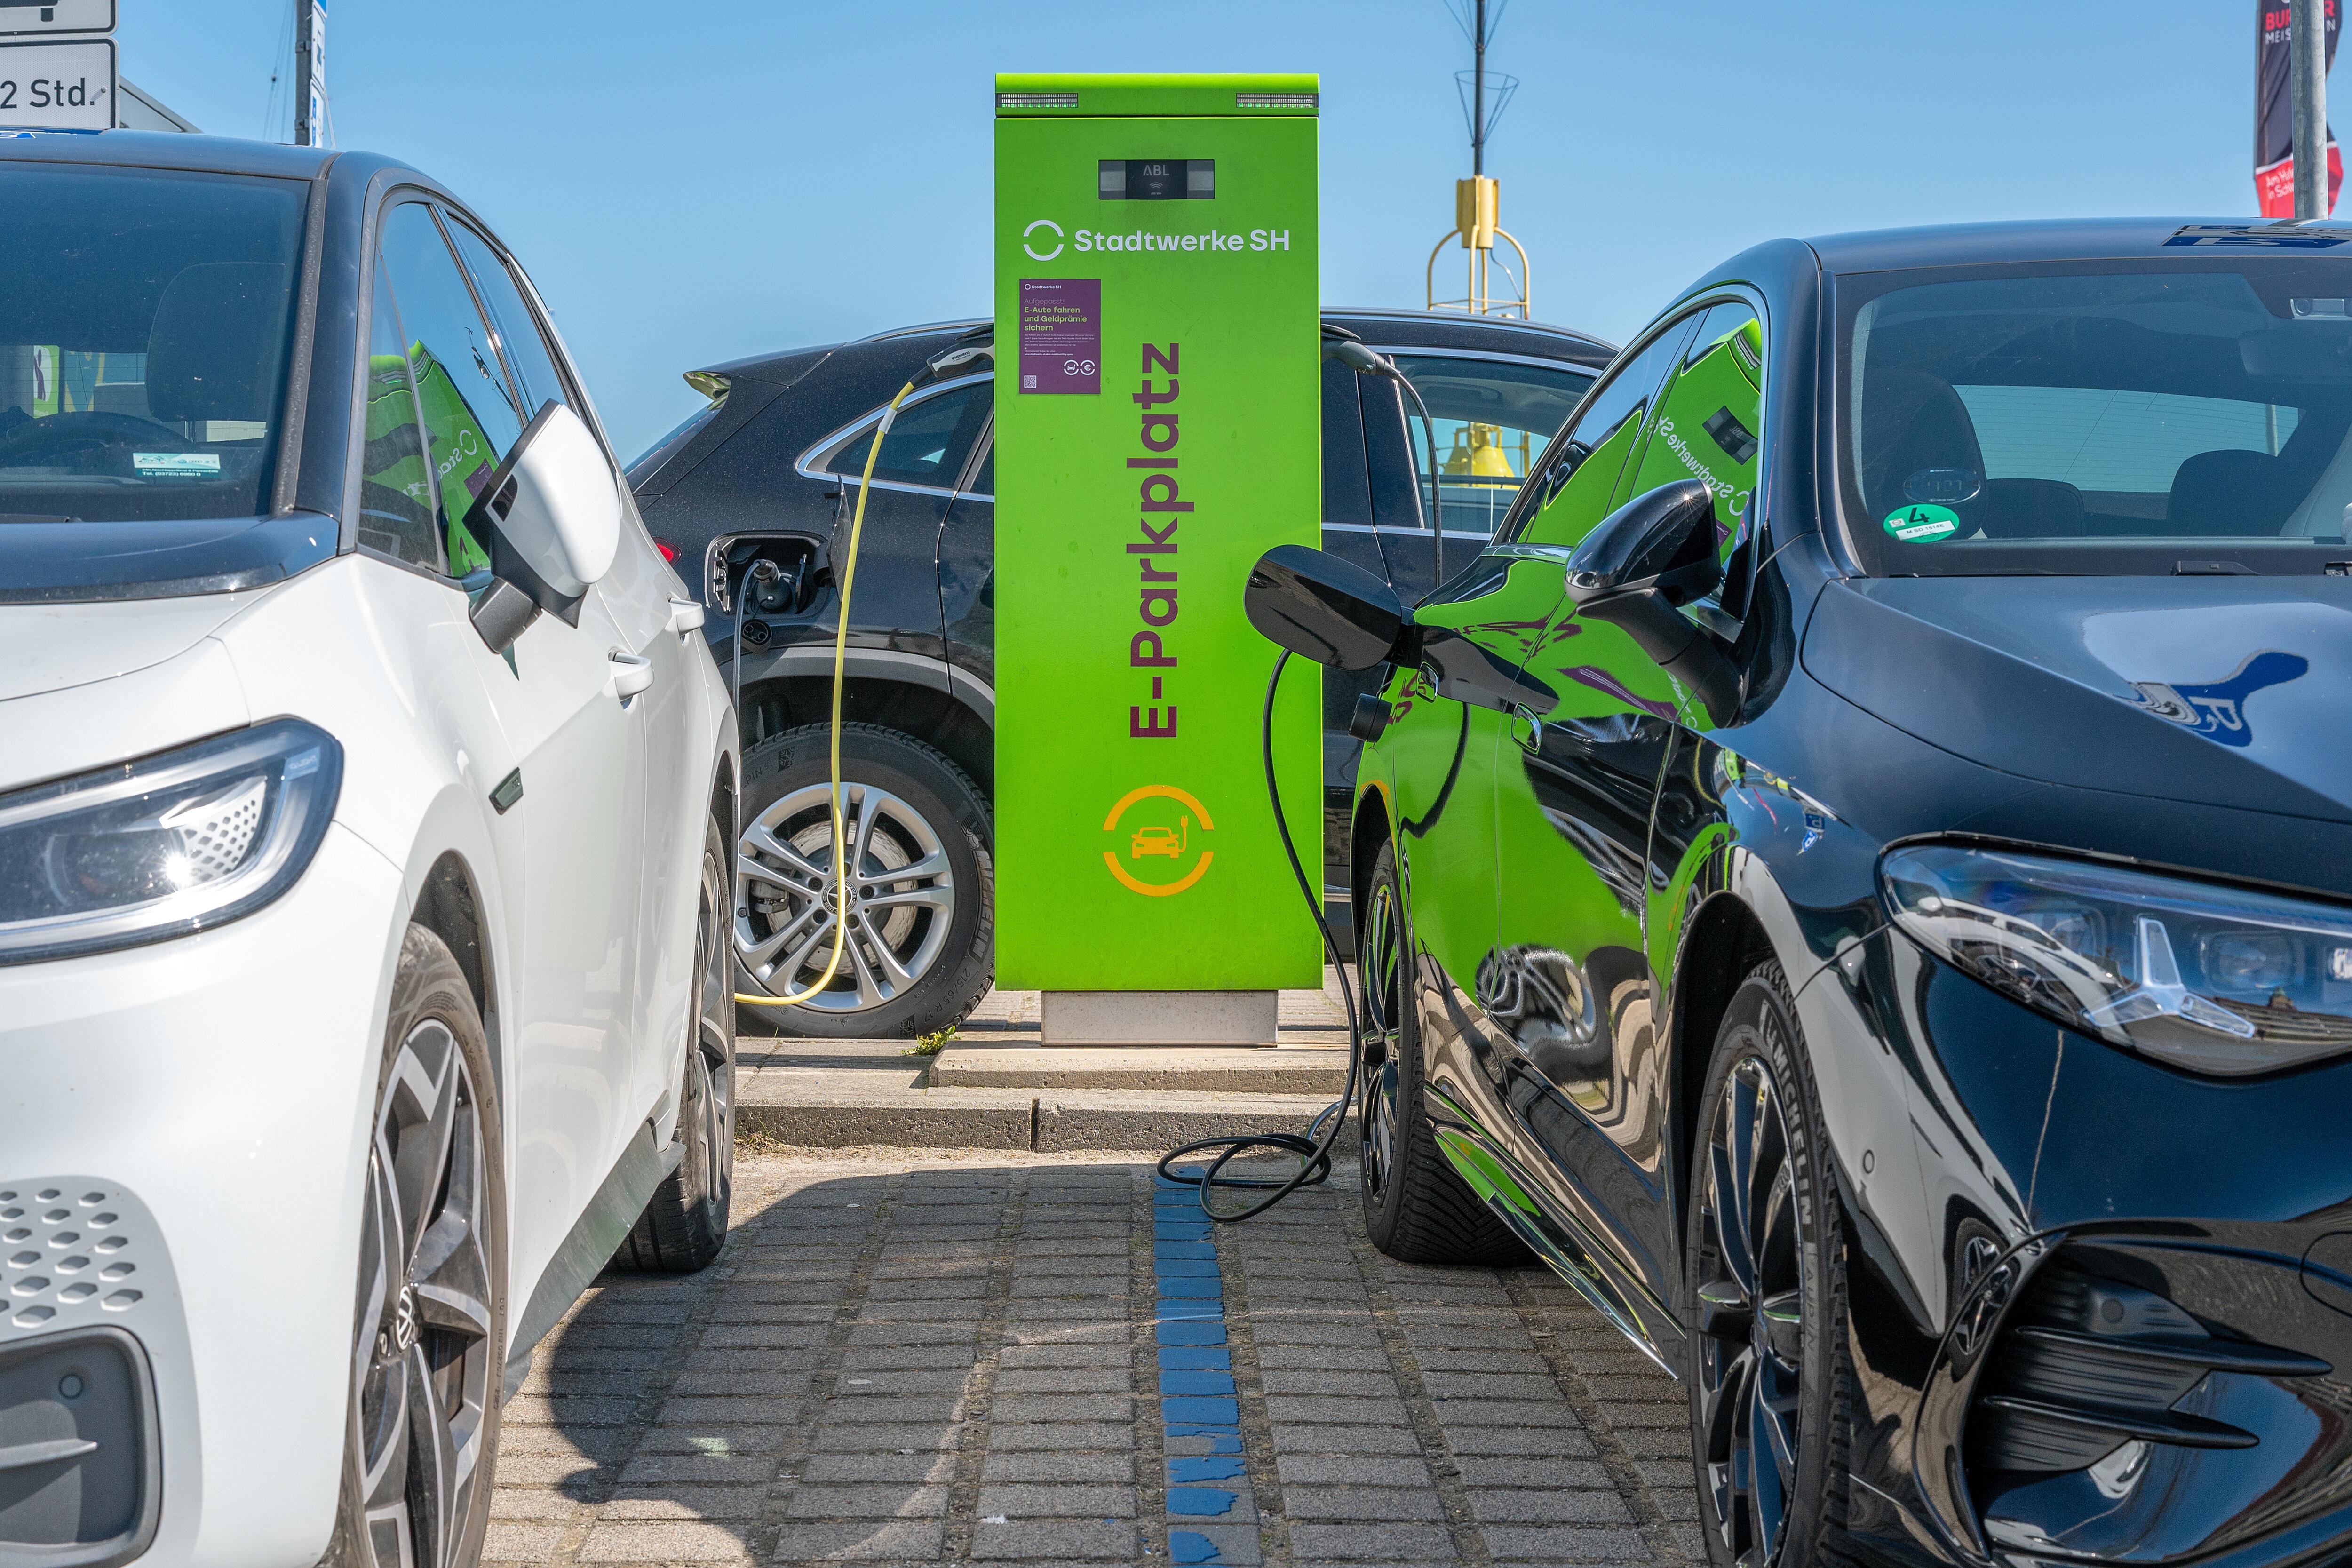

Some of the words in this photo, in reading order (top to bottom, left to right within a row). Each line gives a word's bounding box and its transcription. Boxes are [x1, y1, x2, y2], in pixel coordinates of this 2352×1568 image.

[0, 81, 17, 109] 2
[30, 77, 95, 108] Std.
[1143, 165, 1169, 176] ABL
[1074, 229, 1244, 252] Stadtwerke
[1249, 229, 1289, 251] SH
[1041, 315, 1087, 324] Geldprämie
[1909, 507, 1930, 523] 4
[1126, 343, 1194, 738] E-Parkplatz
[972, 850, 995, 959] MICHELIN
[943, 968, 971, 1004] 215/65
[925, 1010, 934, 1022] 17
[934, 1002, 943, 1012] R
[1773, 1041, 1812, 1224] MICHELIN
